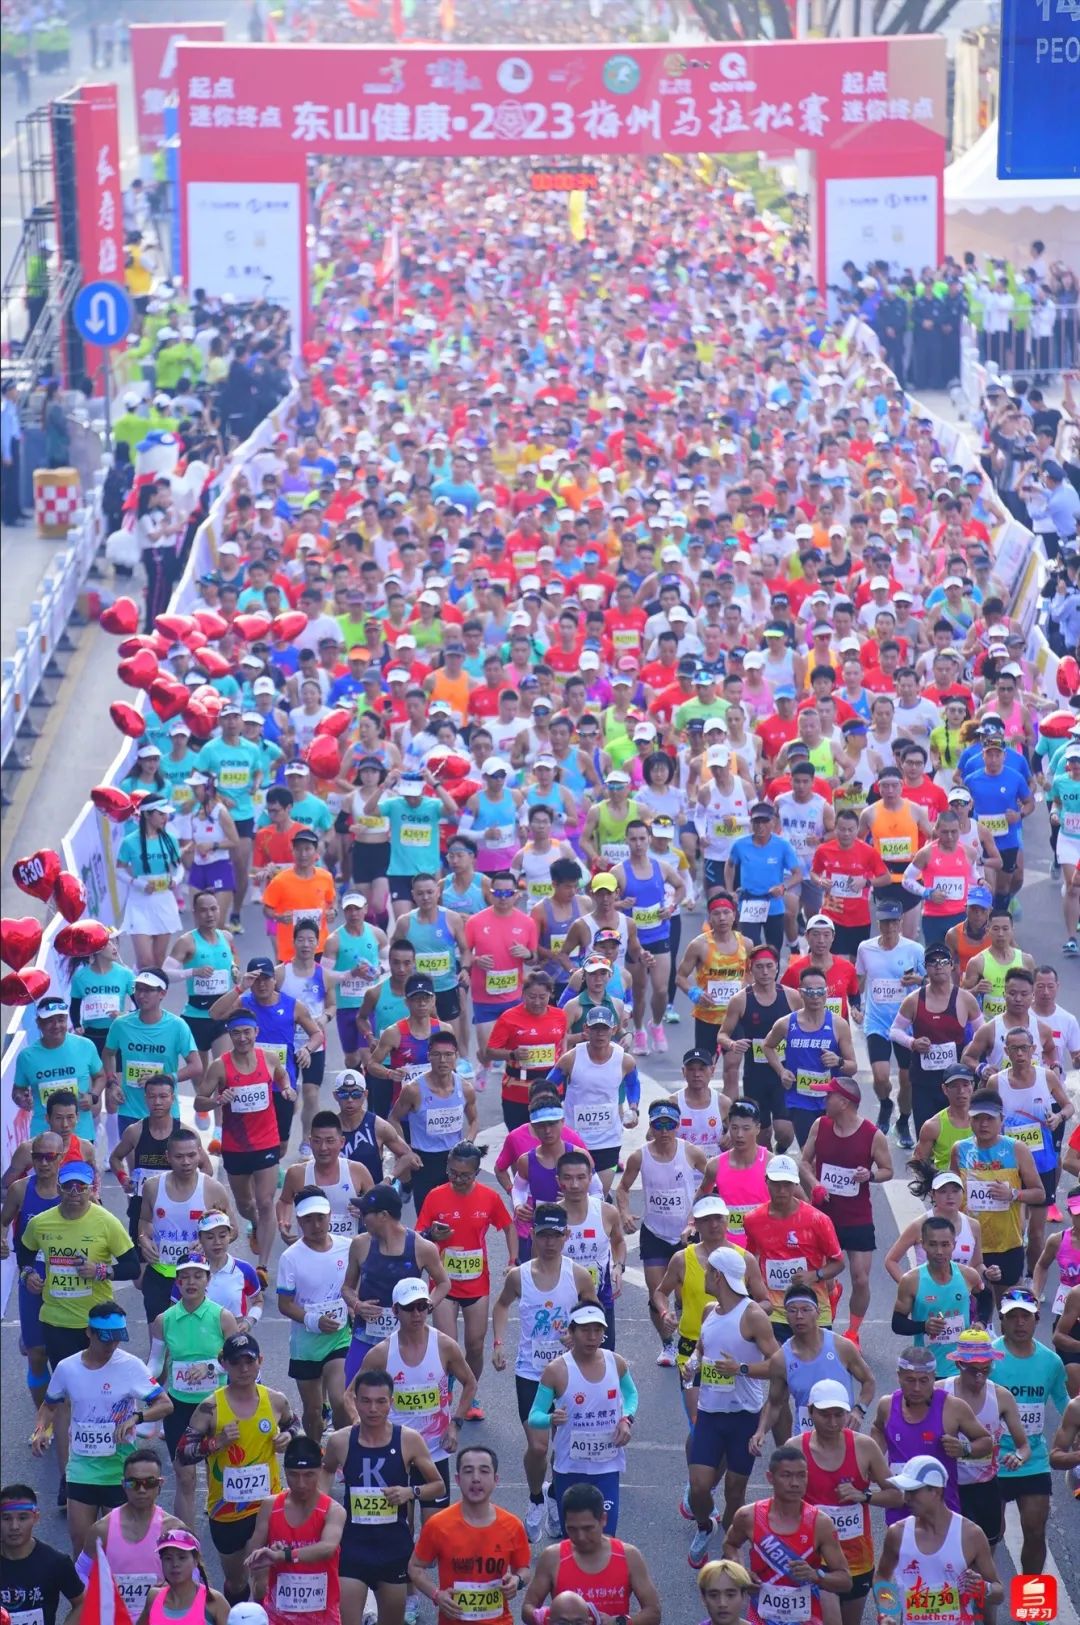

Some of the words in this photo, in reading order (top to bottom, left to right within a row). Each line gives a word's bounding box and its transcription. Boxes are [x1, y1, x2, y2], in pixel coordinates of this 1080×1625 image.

[19, 858, 44, 886] 5:30
[418, 959, 448, 969] A2673
[128, 1042, 166, 1054] COFIND
[528, 1050, 552, 1059] 2135
[923, 1050, 954, 1062] A0208
[36, 1067, 76, 1080] COFIND
[233, 1091, 266, 1104] A0698
[577, 1112, 610, 1123] A0755
[824, 1173, 857, 1188] A0294
[649, 1195, 682, 1207] A0243
[447, 1257, 481, 1270] A2198
[397, 1392, 436, 1406] A2619
[1020, 1412, 1041, 1424] 483
[74, 1431, 112, 1444] A0556
[226, 1474, 266, 1490] A0727
[117, 1584, 151, 1598] 0447
[458, 1591, 500, 1606] A2708
[762, 1593, 806, 1609] A0813
